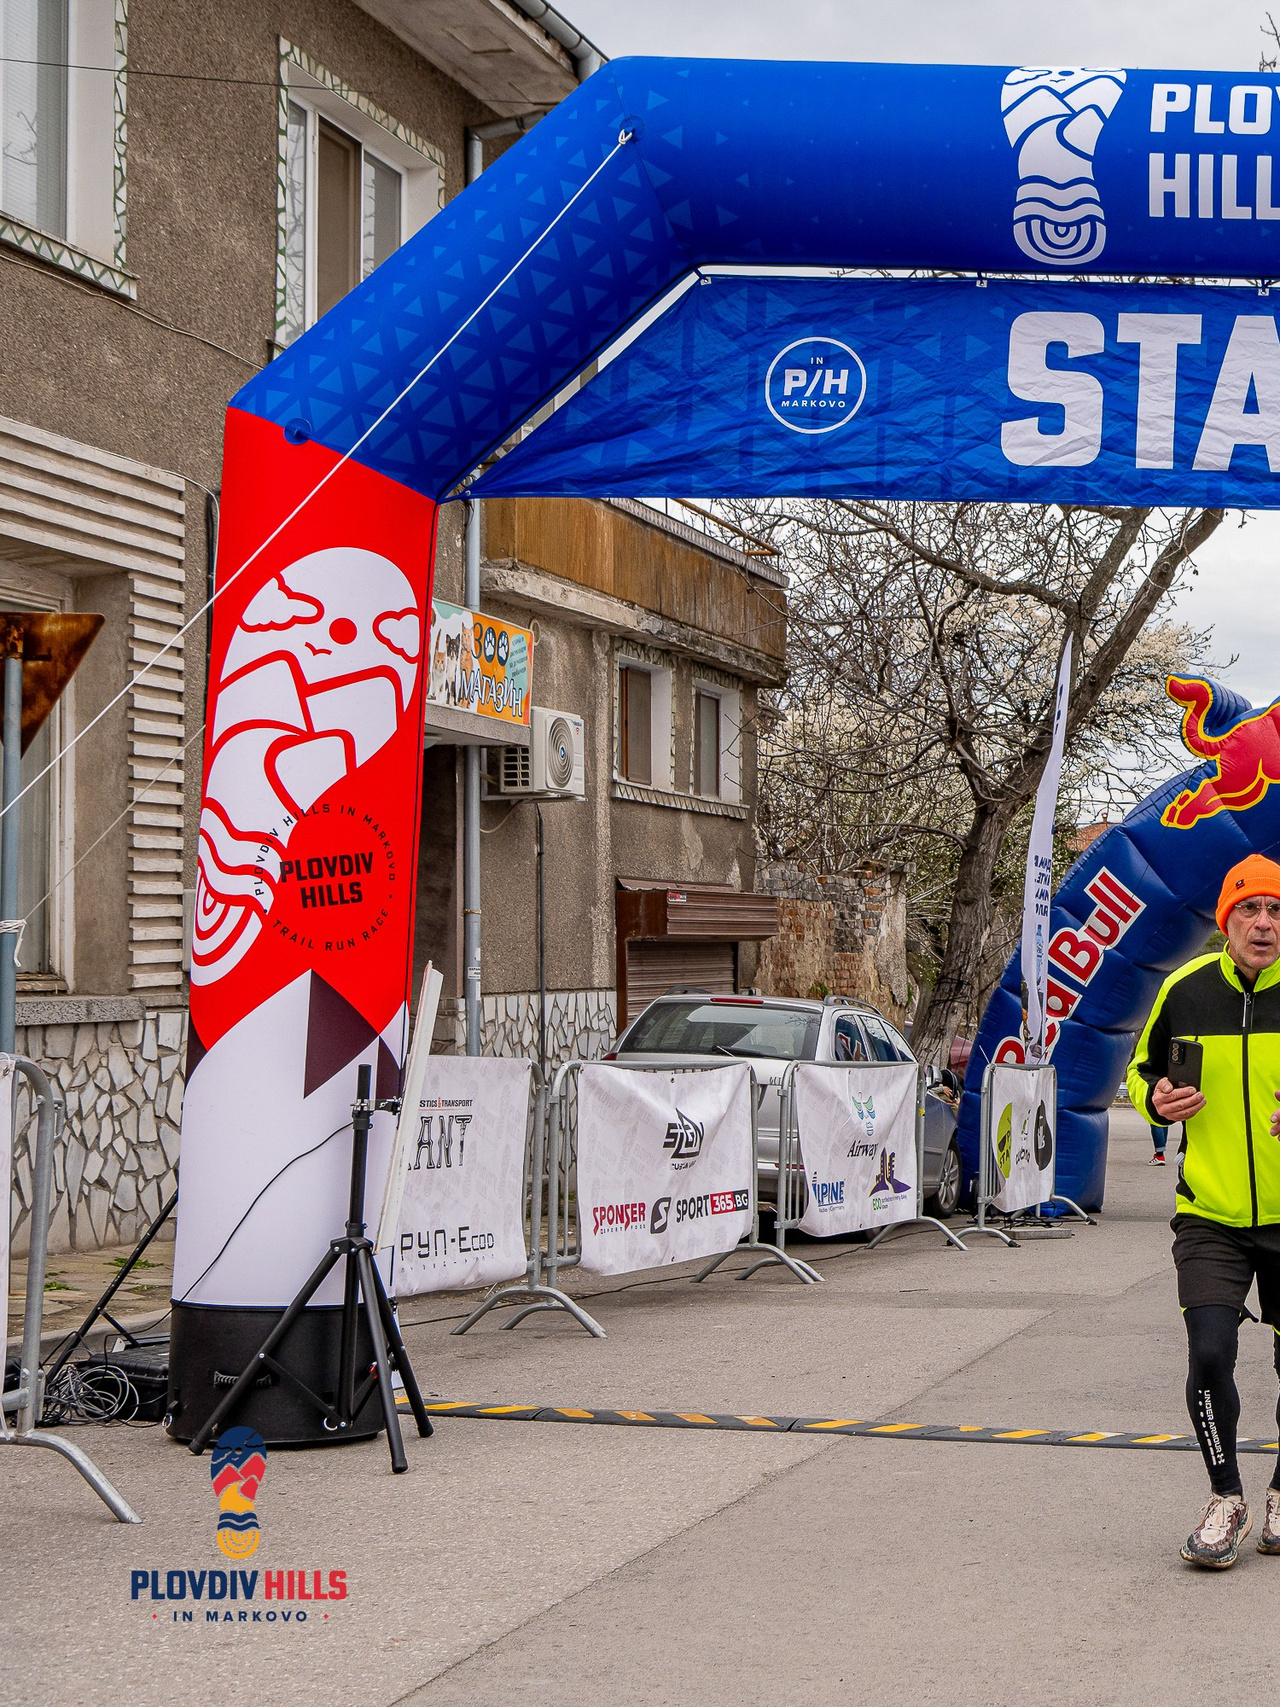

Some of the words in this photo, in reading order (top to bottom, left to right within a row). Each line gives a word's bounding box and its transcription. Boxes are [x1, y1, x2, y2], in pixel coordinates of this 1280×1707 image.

[783, 369, 849, 397] P/H
[781, 400, 846, 408] MARKOVO
[460, 669, 522, 717] МАГАЗИН
[254, 828, 279, 896] PLOVDIV
[283, 803, 331, 826] HILLS
[340, 805, 356, 816] IN
[363, 814, 395, 881] MARKOVO
[279, 852, 374, 883] PLOVDIV
[300, 882, 363, 909] HILLS
[272, 920, 314, 949] TRAIL
[325, 938, 356, 950] RUN
[362, 908, 389, 941] RACE
[1048, 868, 1145, 985] Bull
[419, 1099, 437, 1108] STICS
[441, 1099, 473, 1107] TRANSPORT
[413, 1114, 473, 1170] ANT
[847, 1140, 879, 1160] Airway
[592, 1202, 646, 1236] SPONSER
[1204, 1389, 1214, 1421] UNDER
[1208, 1420, 1222, 1454] ARMOUR
